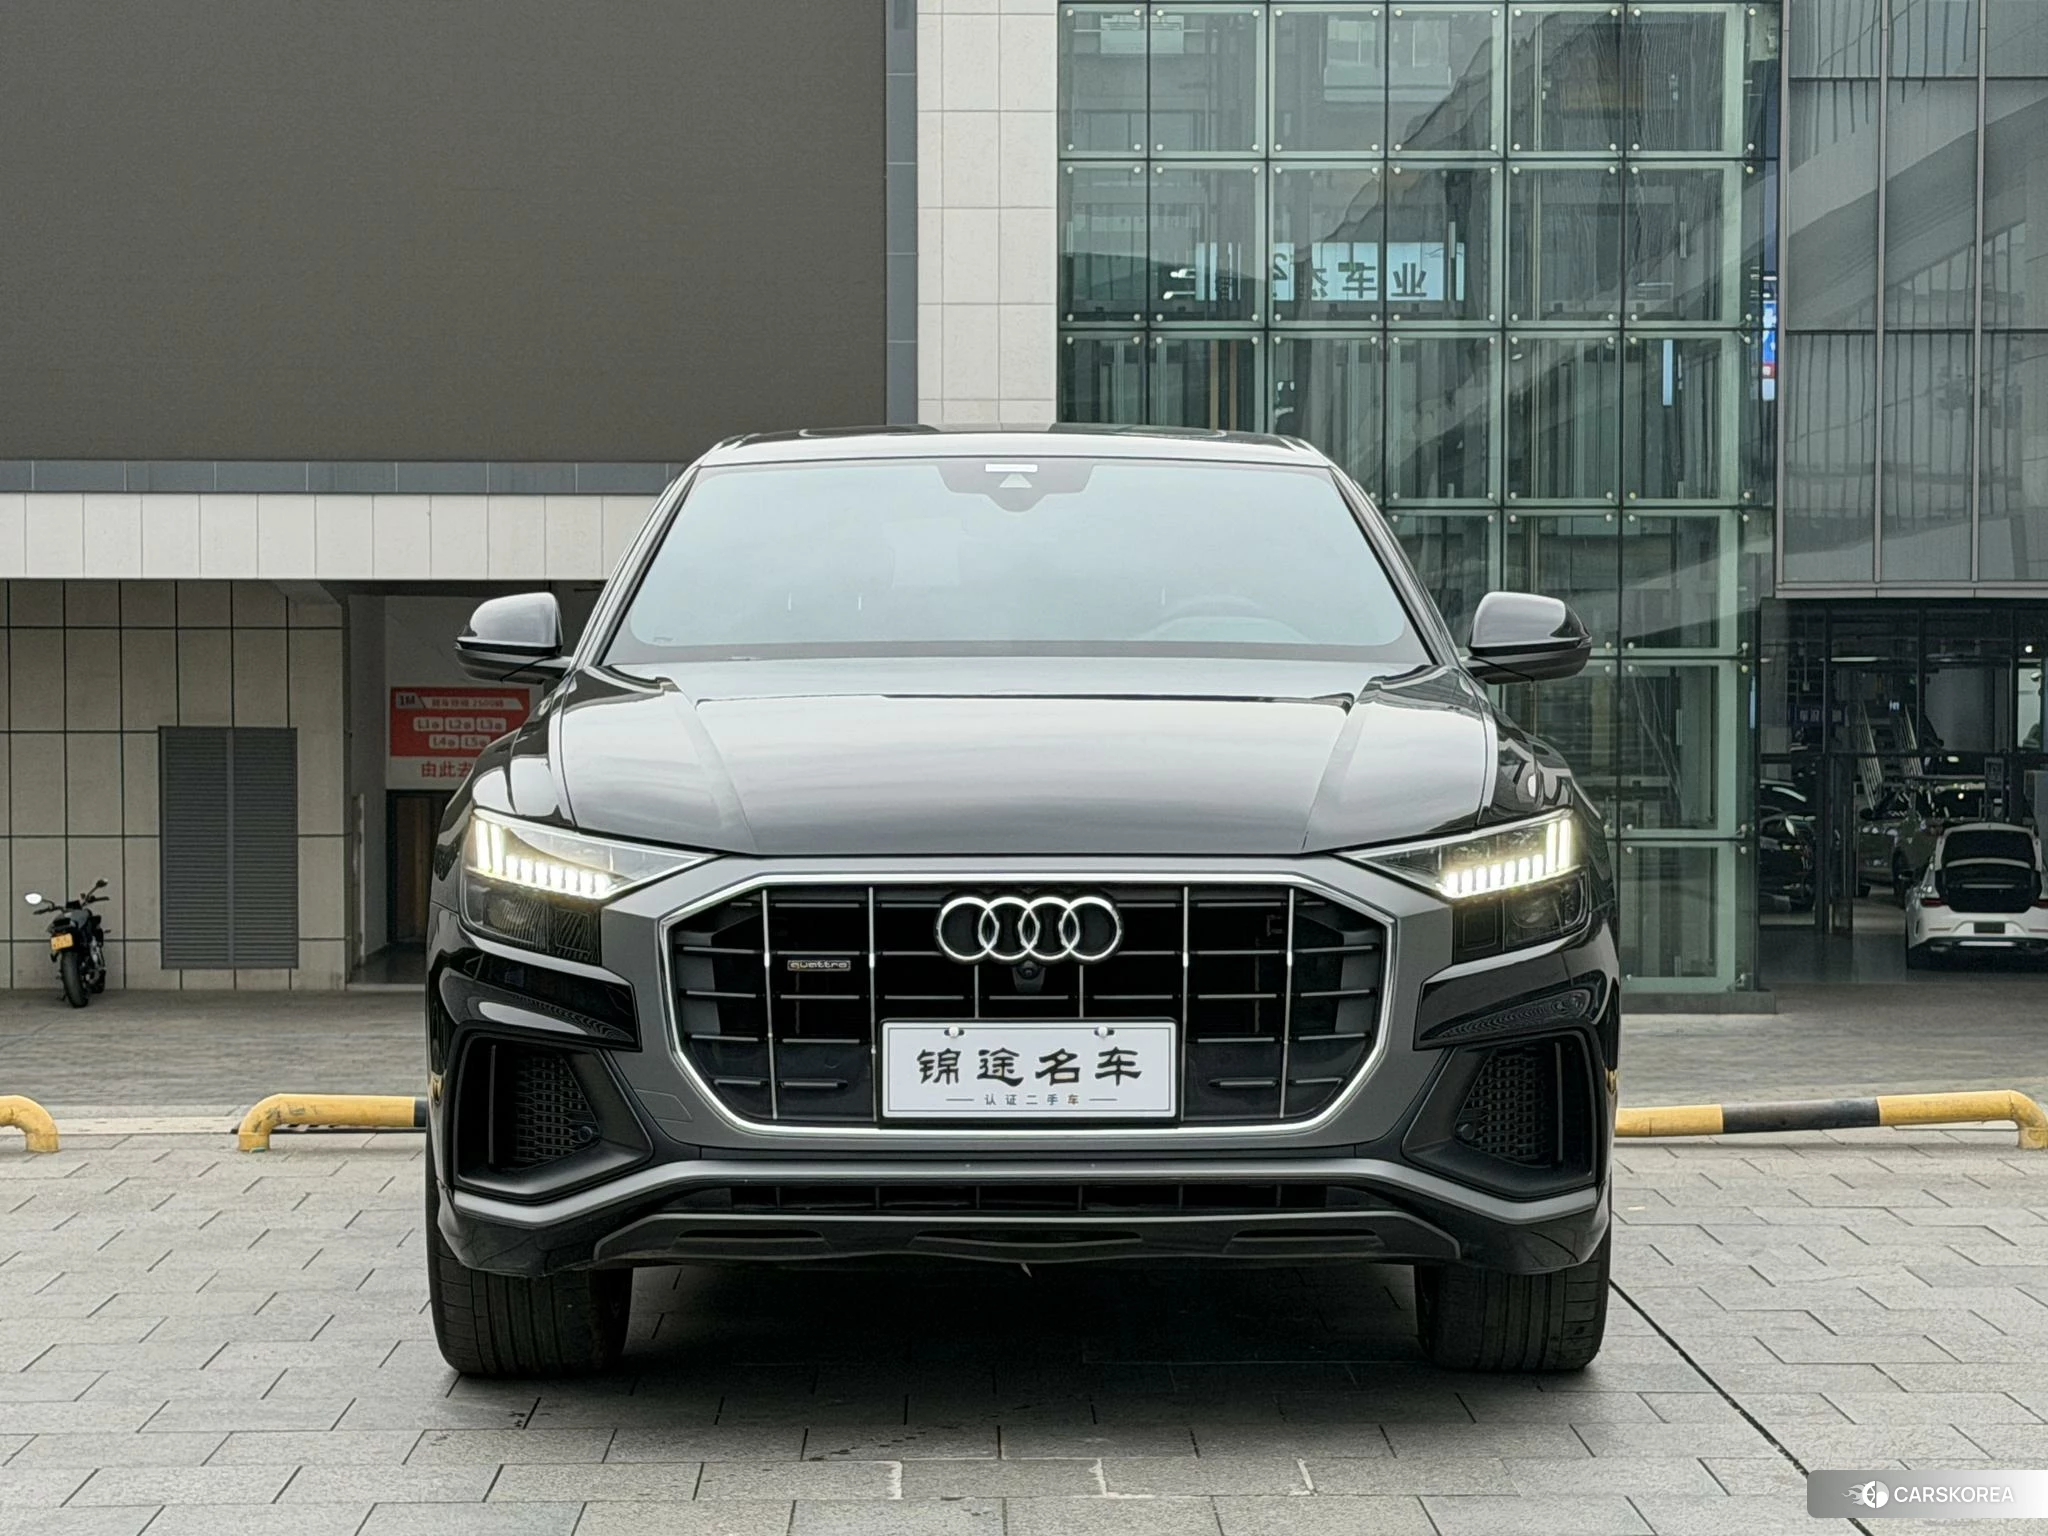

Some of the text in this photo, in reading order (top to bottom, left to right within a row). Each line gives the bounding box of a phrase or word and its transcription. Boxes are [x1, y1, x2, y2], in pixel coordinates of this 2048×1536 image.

[790, 961, 848, 970] quattro
[916, 1047, 1143, 1087] 锦途名车
[984, 1093, 1080, 1106] 认证二手车
